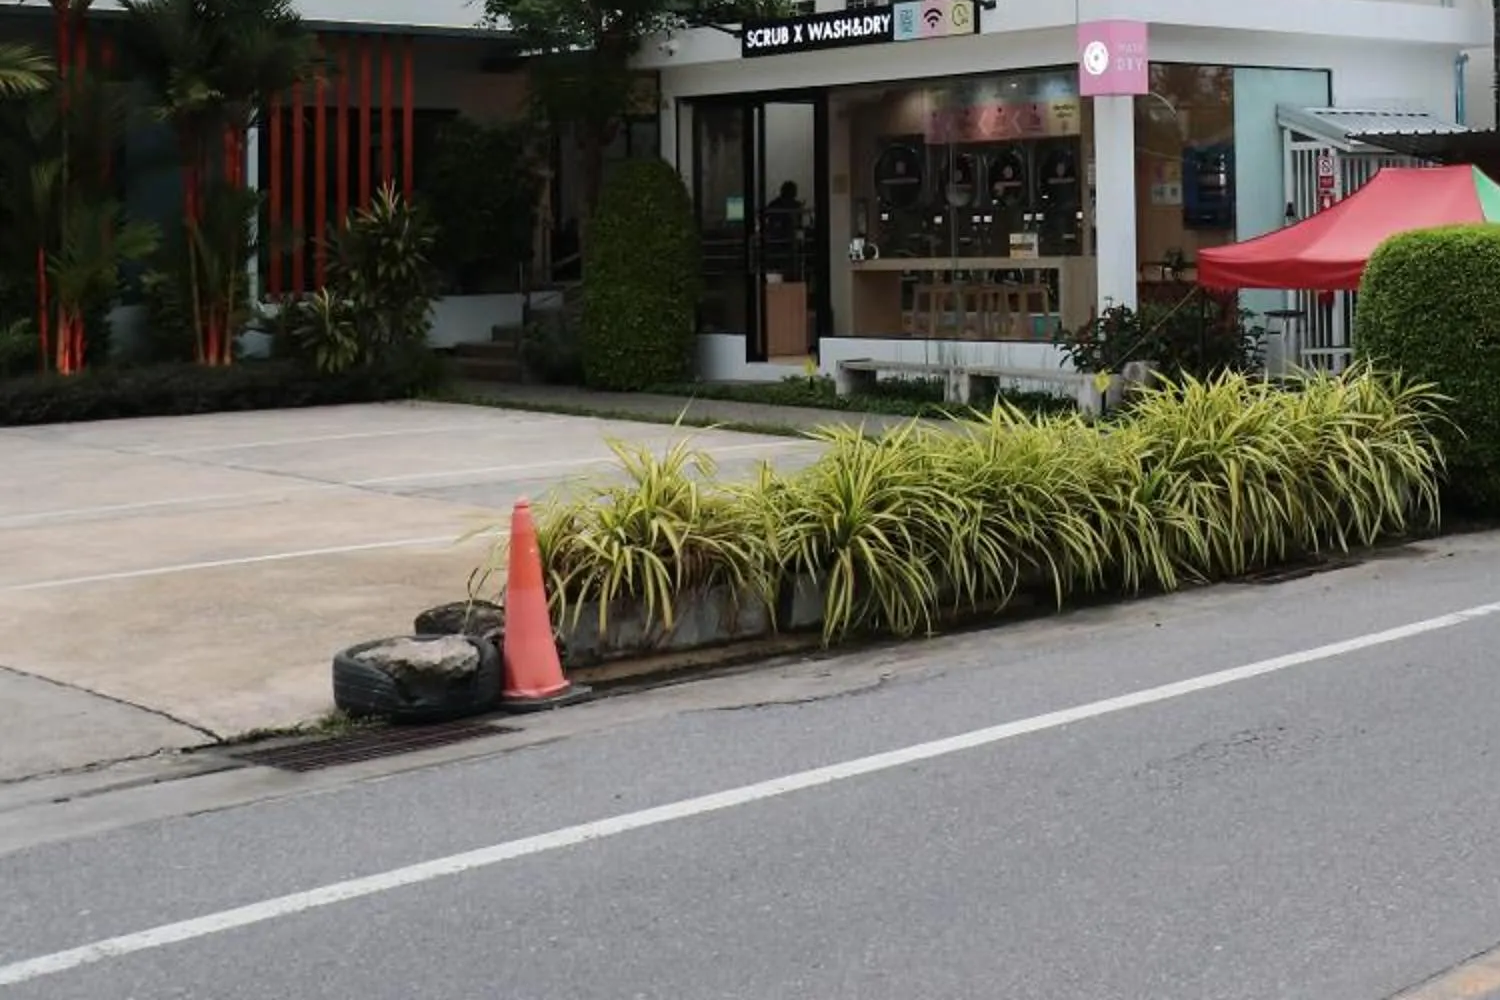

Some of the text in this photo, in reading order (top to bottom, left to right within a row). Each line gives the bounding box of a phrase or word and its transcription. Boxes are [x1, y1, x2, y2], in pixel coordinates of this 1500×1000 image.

[746, 30, 789, 48] SCRUB
[793, 24, 803, 43] X
[807, 14, 891, 41] WASH&DRY
